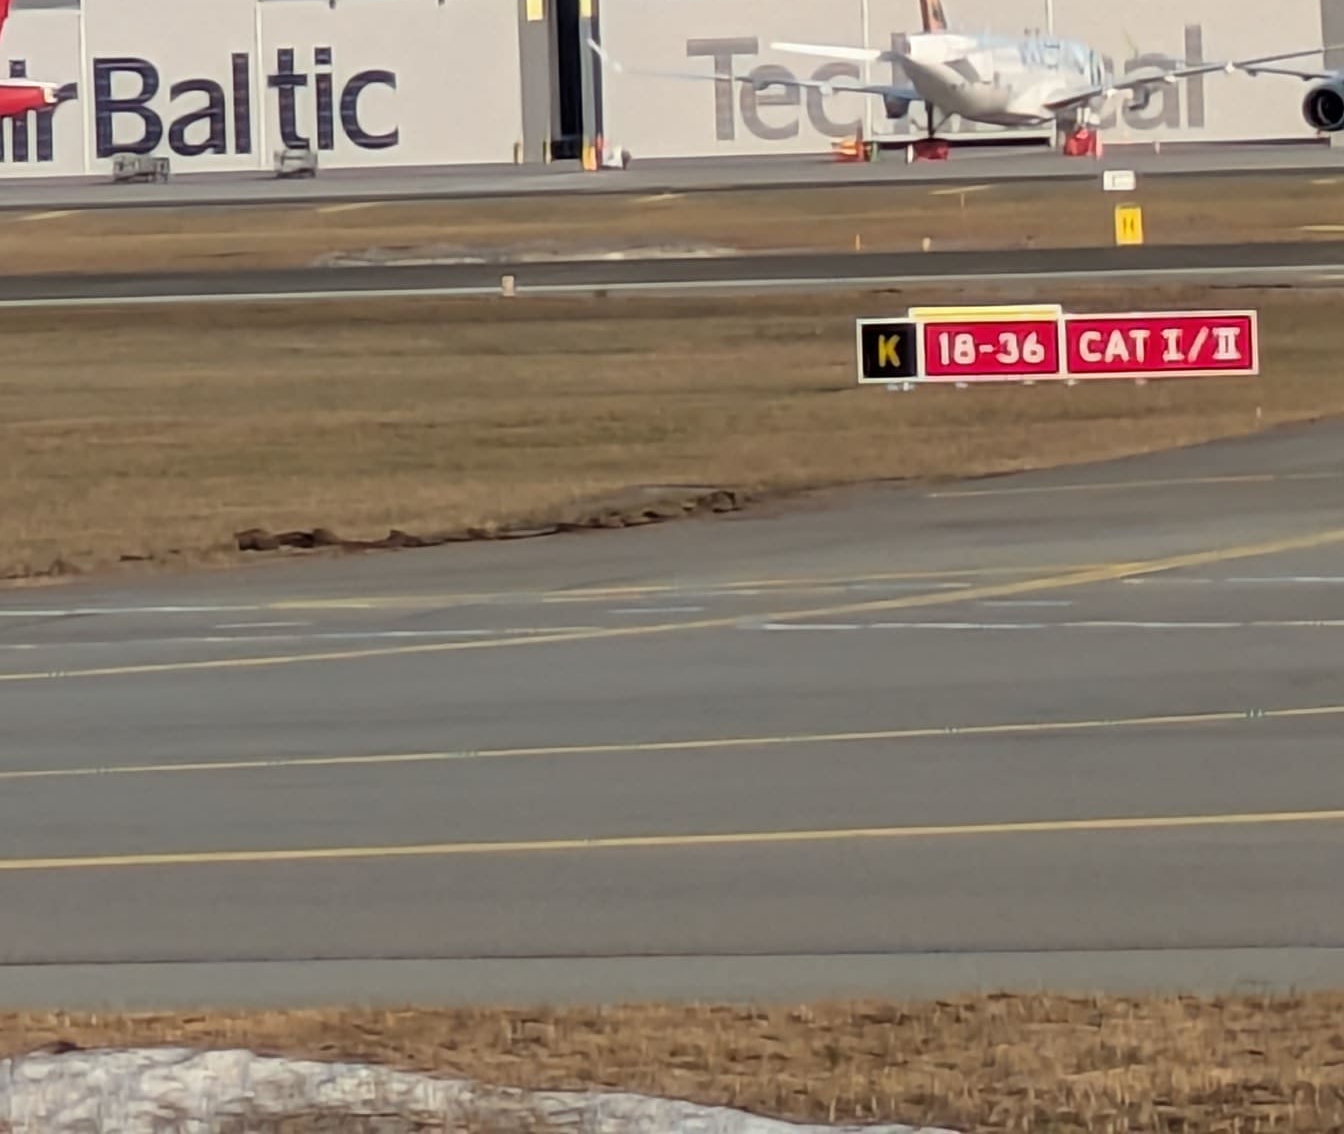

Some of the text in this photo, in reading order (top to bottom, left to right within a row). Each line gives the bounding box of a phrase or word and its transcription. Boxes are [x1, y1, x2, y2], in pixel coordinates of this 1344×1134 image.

[877, 326, 1242, 367] K 18-36 CAT I/II
